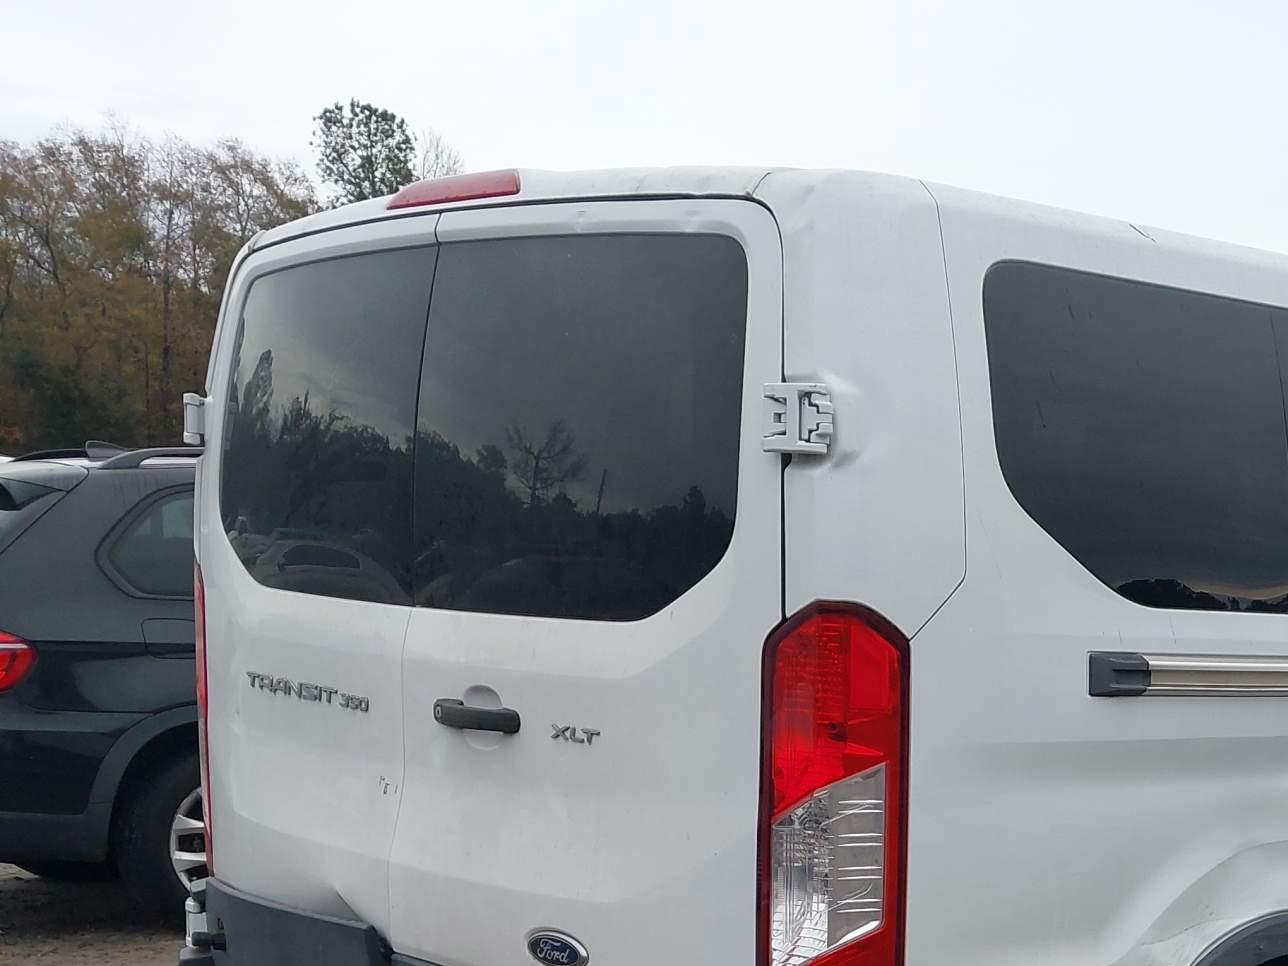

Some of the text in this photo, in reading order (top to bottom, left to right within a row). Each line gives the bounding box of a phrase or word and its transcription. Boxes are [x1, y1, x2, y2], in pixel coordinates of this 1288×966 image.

[246, 671, 338, 704] TRANSIT
[551, 723, 600, 745] XLT
[537, 939, 570, 963] Ford
